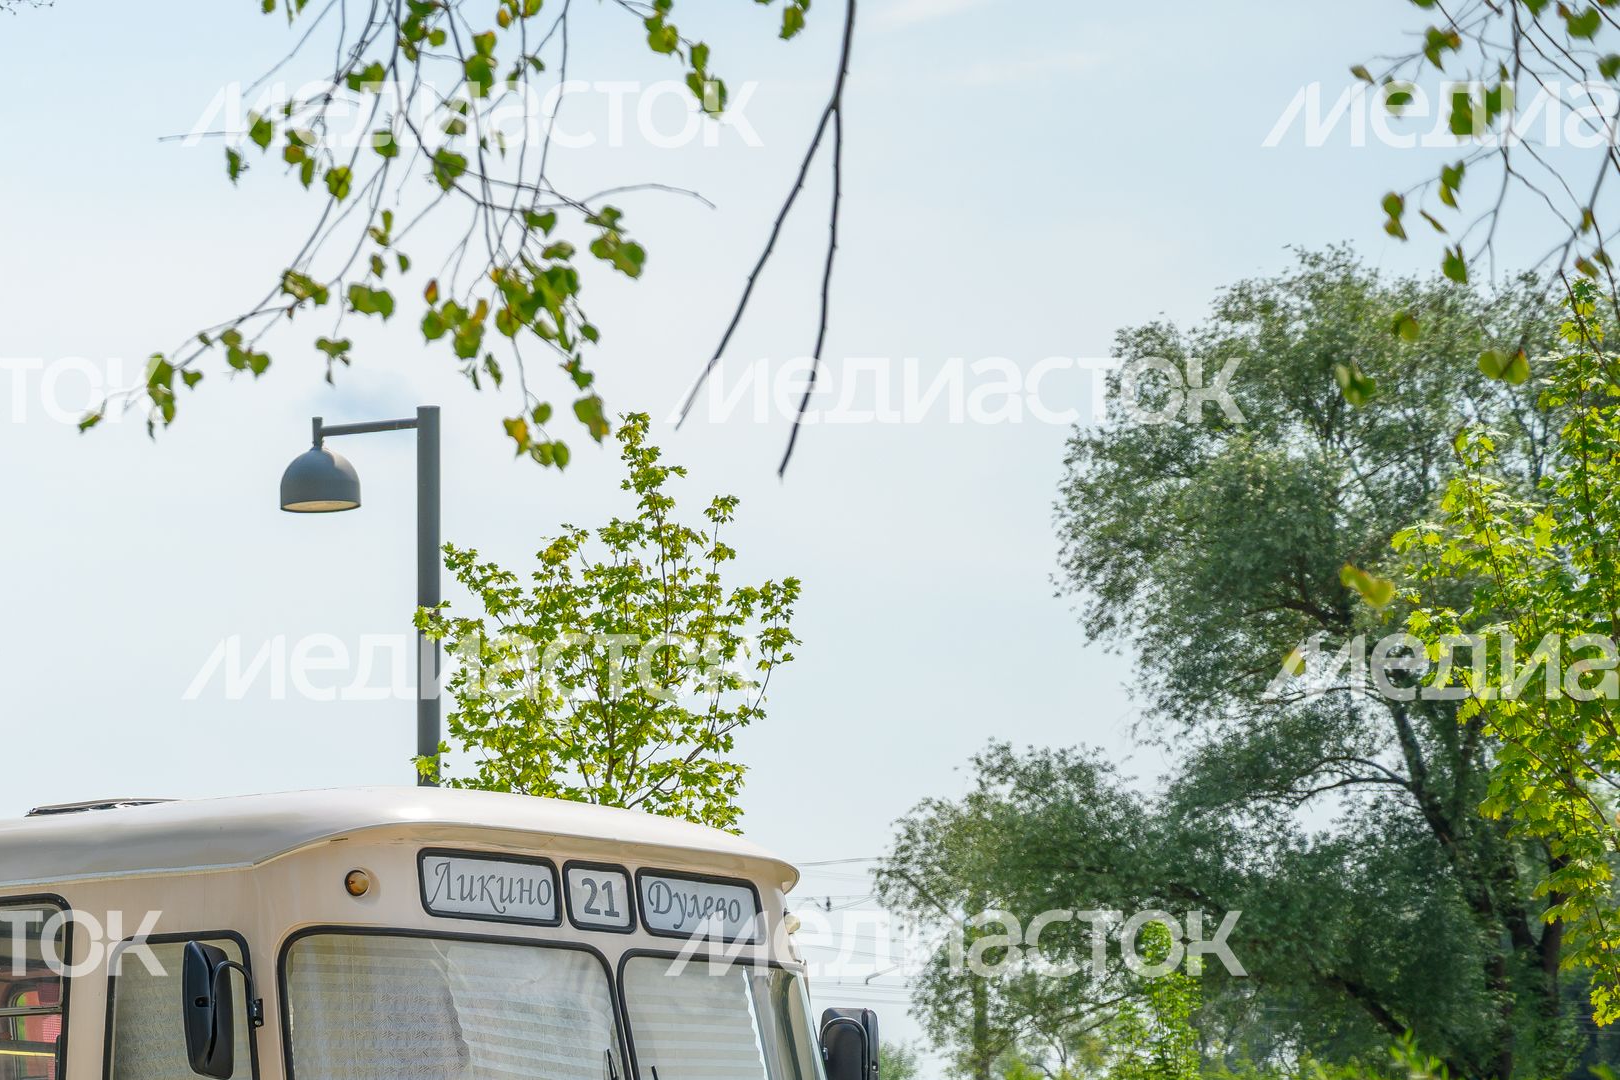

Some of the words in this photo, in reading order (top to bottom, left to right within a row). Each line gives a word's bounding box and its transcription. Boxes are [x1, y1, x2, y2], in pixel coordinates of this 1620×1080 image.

[427, 860, 552, 914] Ликино
[580, 877, 620, 918] 21
[647, 880, 741, 930] Дулево
